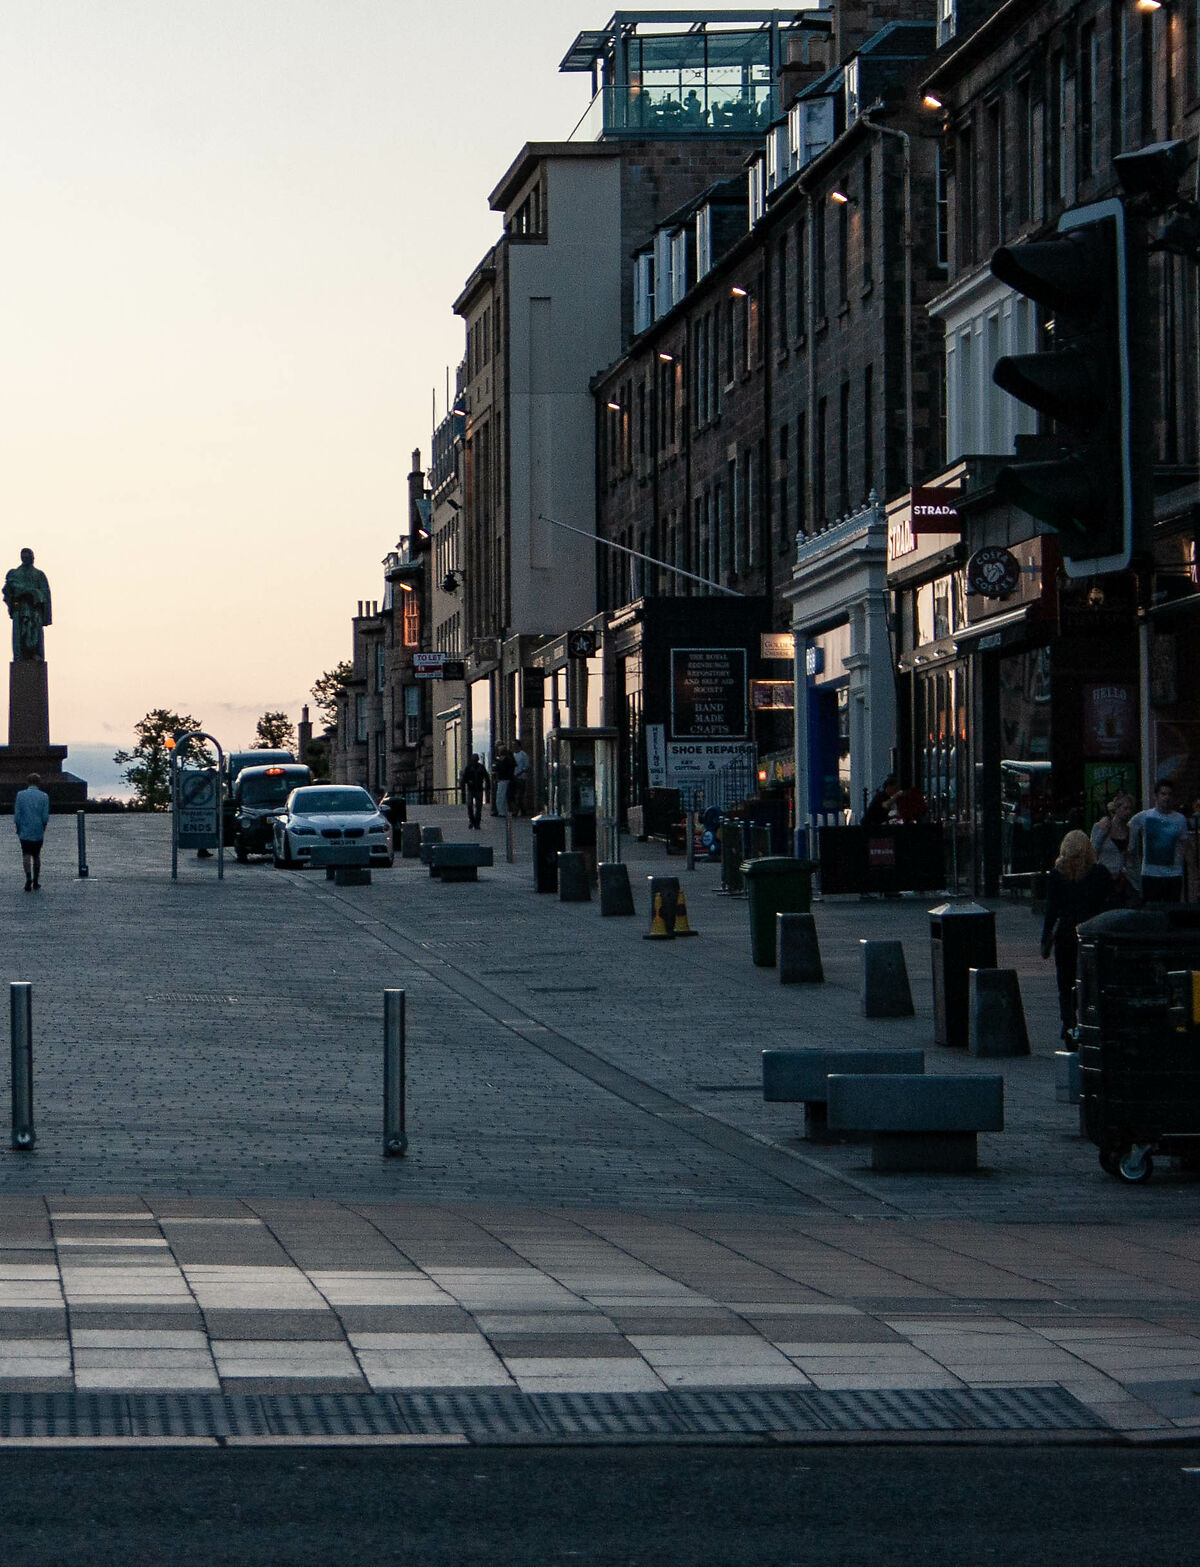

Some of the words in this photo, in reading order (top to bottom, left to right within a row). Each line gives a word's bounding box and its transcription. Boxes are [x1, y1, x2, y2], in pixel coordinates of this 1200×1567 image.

[976, 551, 1008, 565] COSTA
[695, 713, 724, 723] MADE
[689, 725, 729, 734] CRAFTS
[672, 746, 703, 754] SHOE
[183, 824, 212, 832] ENDS
